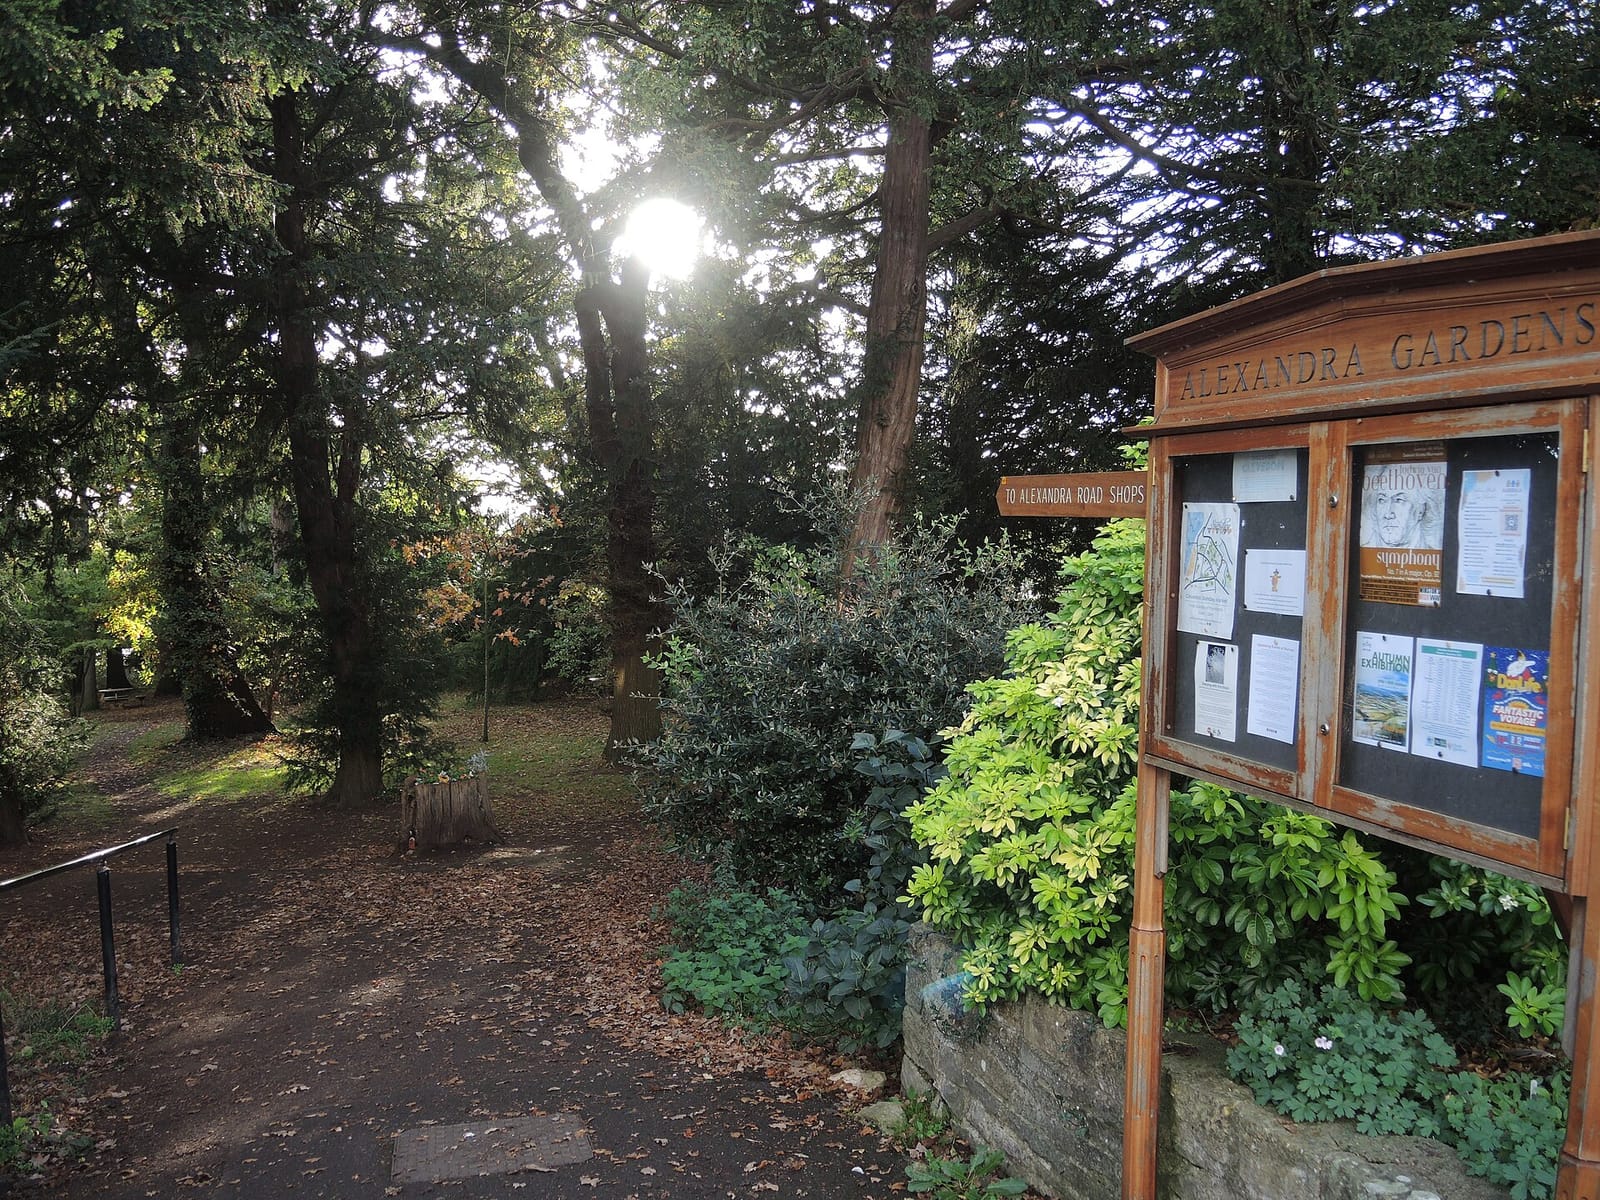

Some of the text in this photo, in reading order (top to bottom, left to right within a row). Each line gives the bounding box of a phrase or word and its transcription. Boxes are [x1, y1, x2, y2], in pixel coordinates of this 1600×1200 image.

[1180, 302, 1596, 401] ALEXANDRA GARDENS
[1005, 485, 1145, 504] TO ALEXANDRA ROAD SHOPS
[1376, 549, 1440, 571] symphony
[1361, 658, 1410, 673] EXHIBITION
[1372, 652, 1410, 665] AUTUMN
[1492, 704, 1545, 720] FANTASTIC
[1501, 714, 1537, 727] VOYAGE
